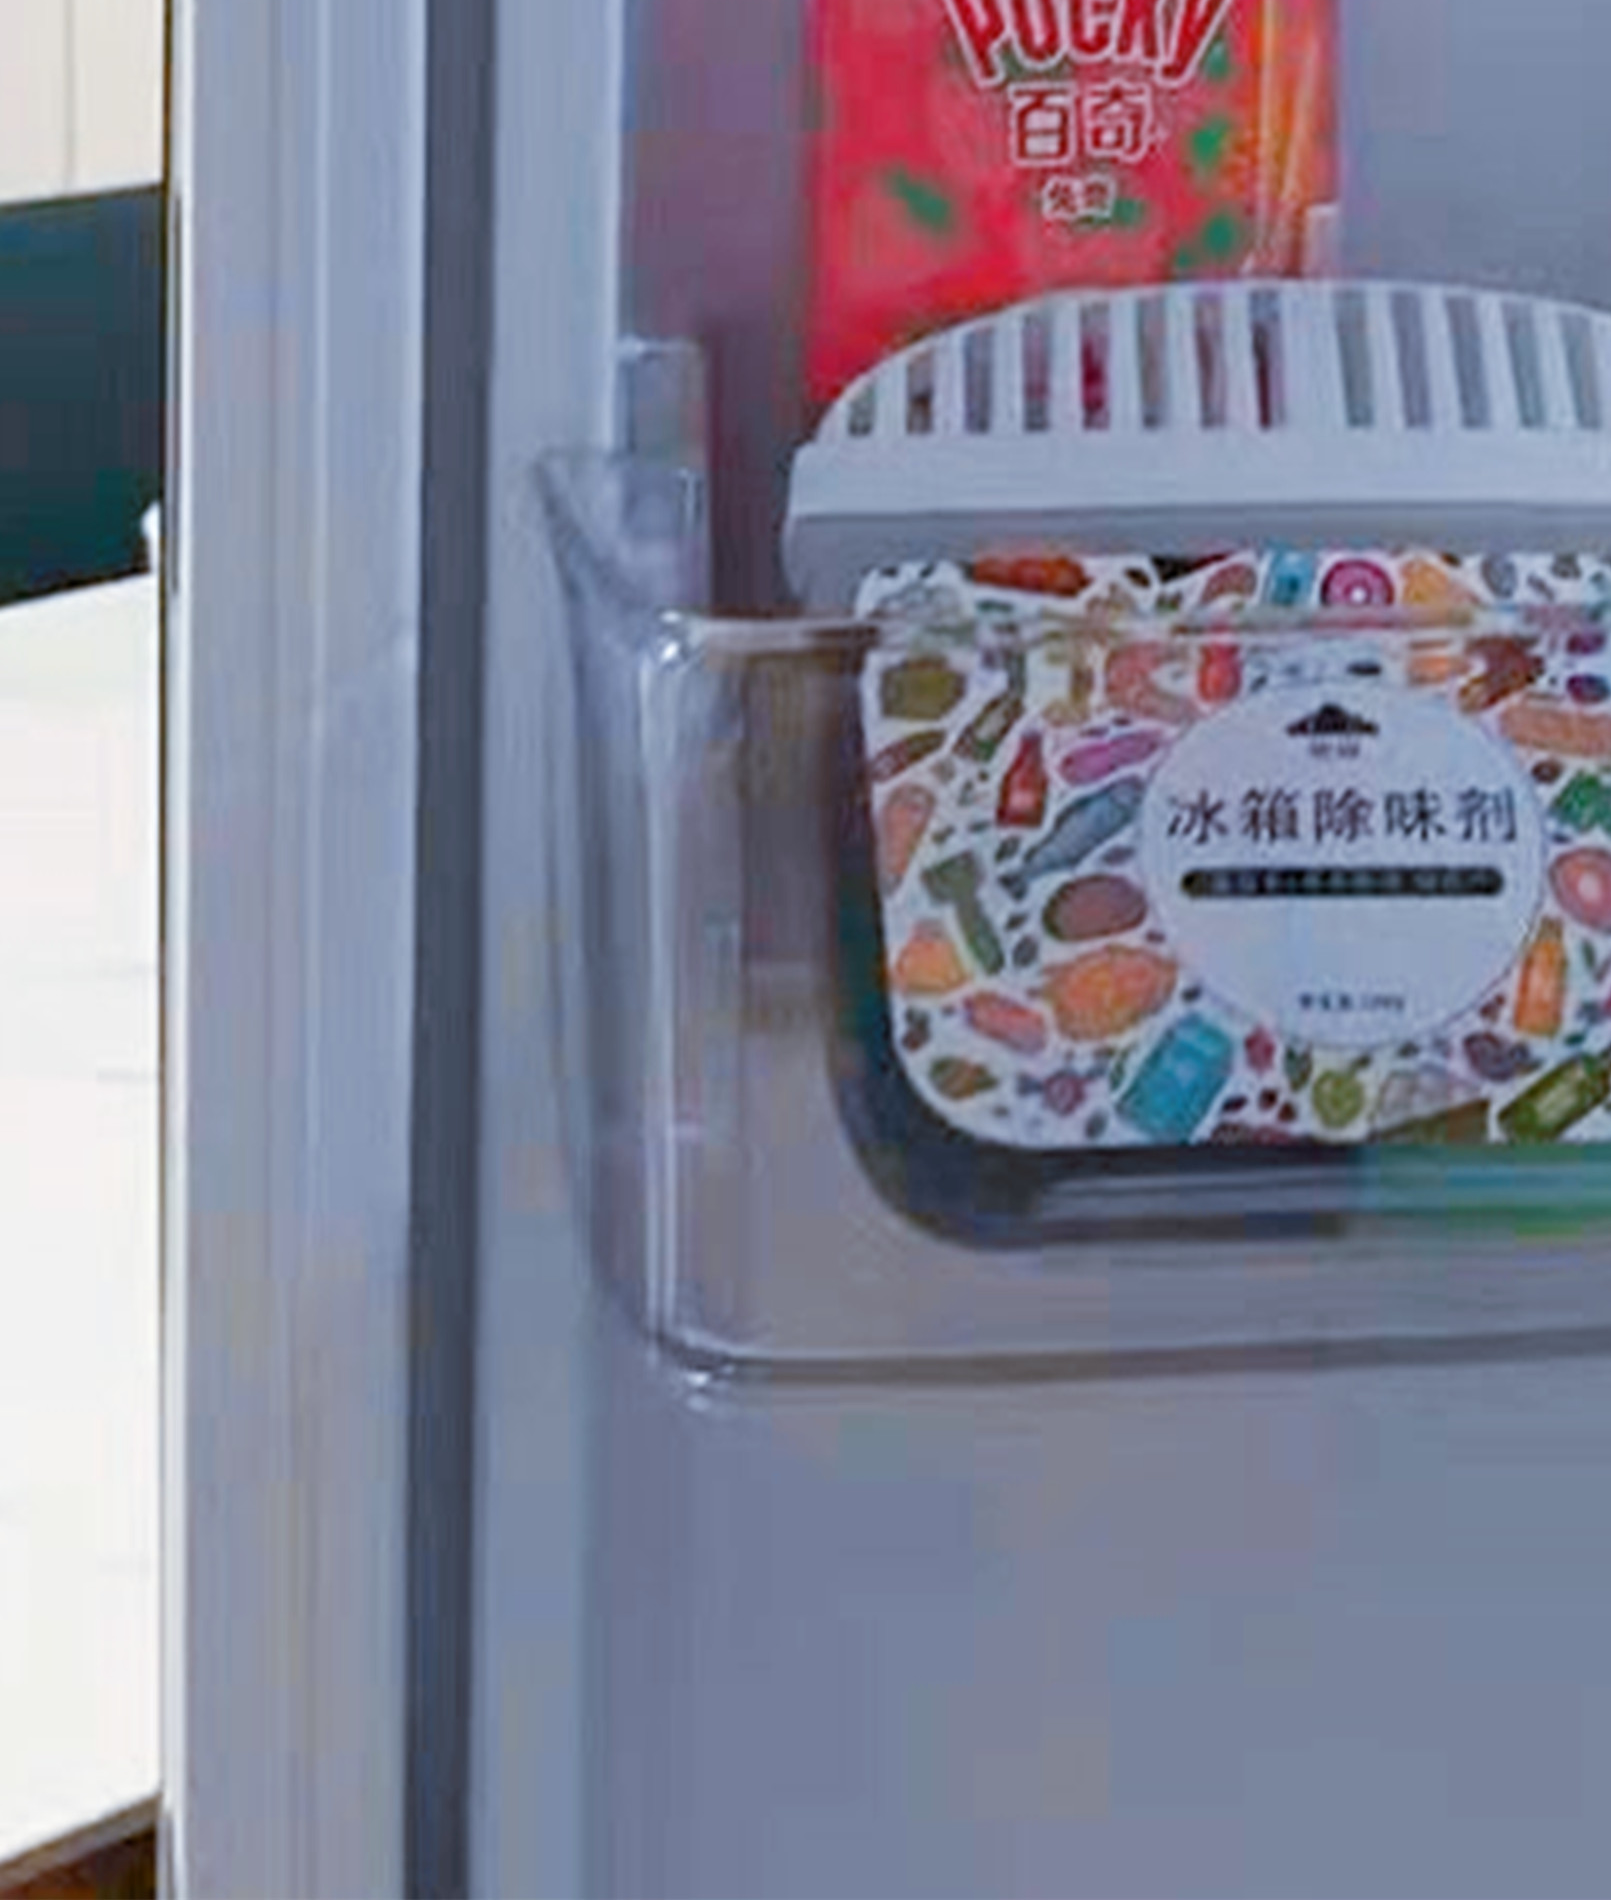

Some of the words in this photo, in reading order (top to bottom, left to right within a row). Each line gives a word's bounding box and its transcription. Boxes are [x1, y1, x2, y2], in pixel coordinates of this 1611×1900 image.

[1008, 80, 1153, 166] 百奇
[1166, 785, 1519, 846] 冰箱除味剂
